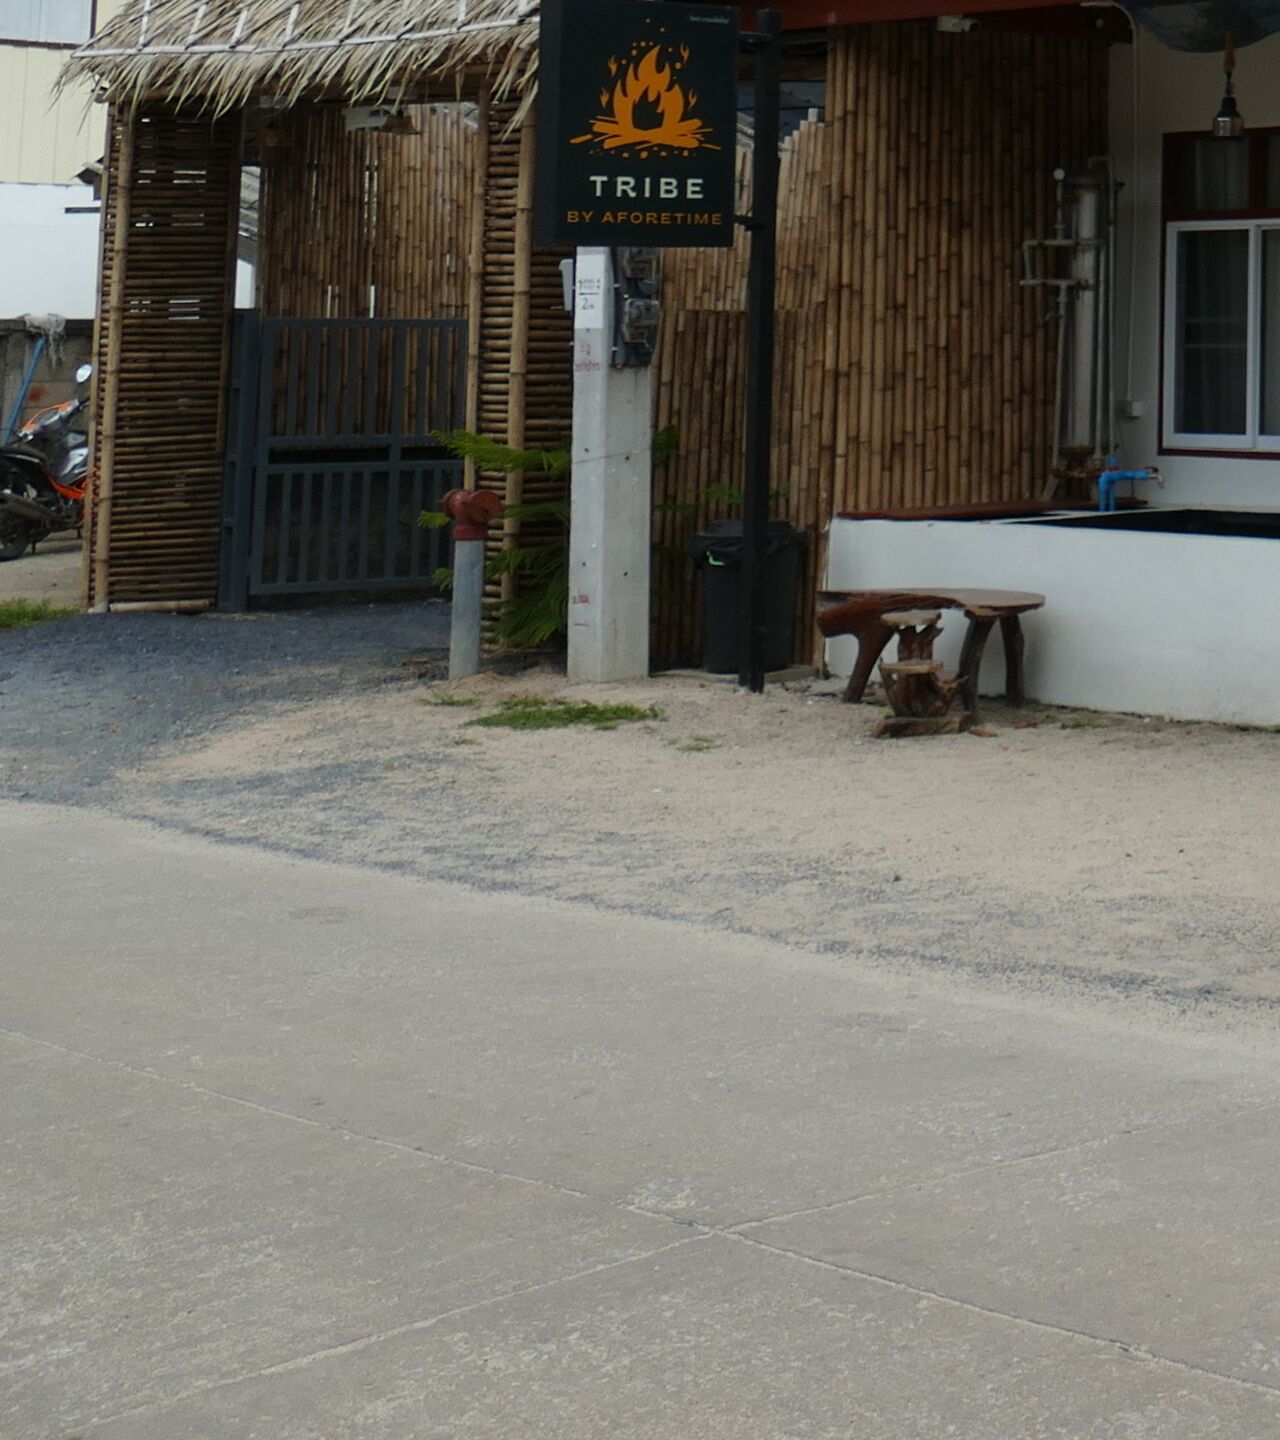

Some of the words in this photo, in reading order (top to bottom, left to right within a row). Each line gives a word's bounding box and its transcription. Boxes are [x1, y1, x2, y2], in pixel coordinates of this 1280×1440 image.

[589, 175, 704, 199] TRIBE
[567, 210, 593, 223] BY
[602, 211, 722, 225] AFORETIME
